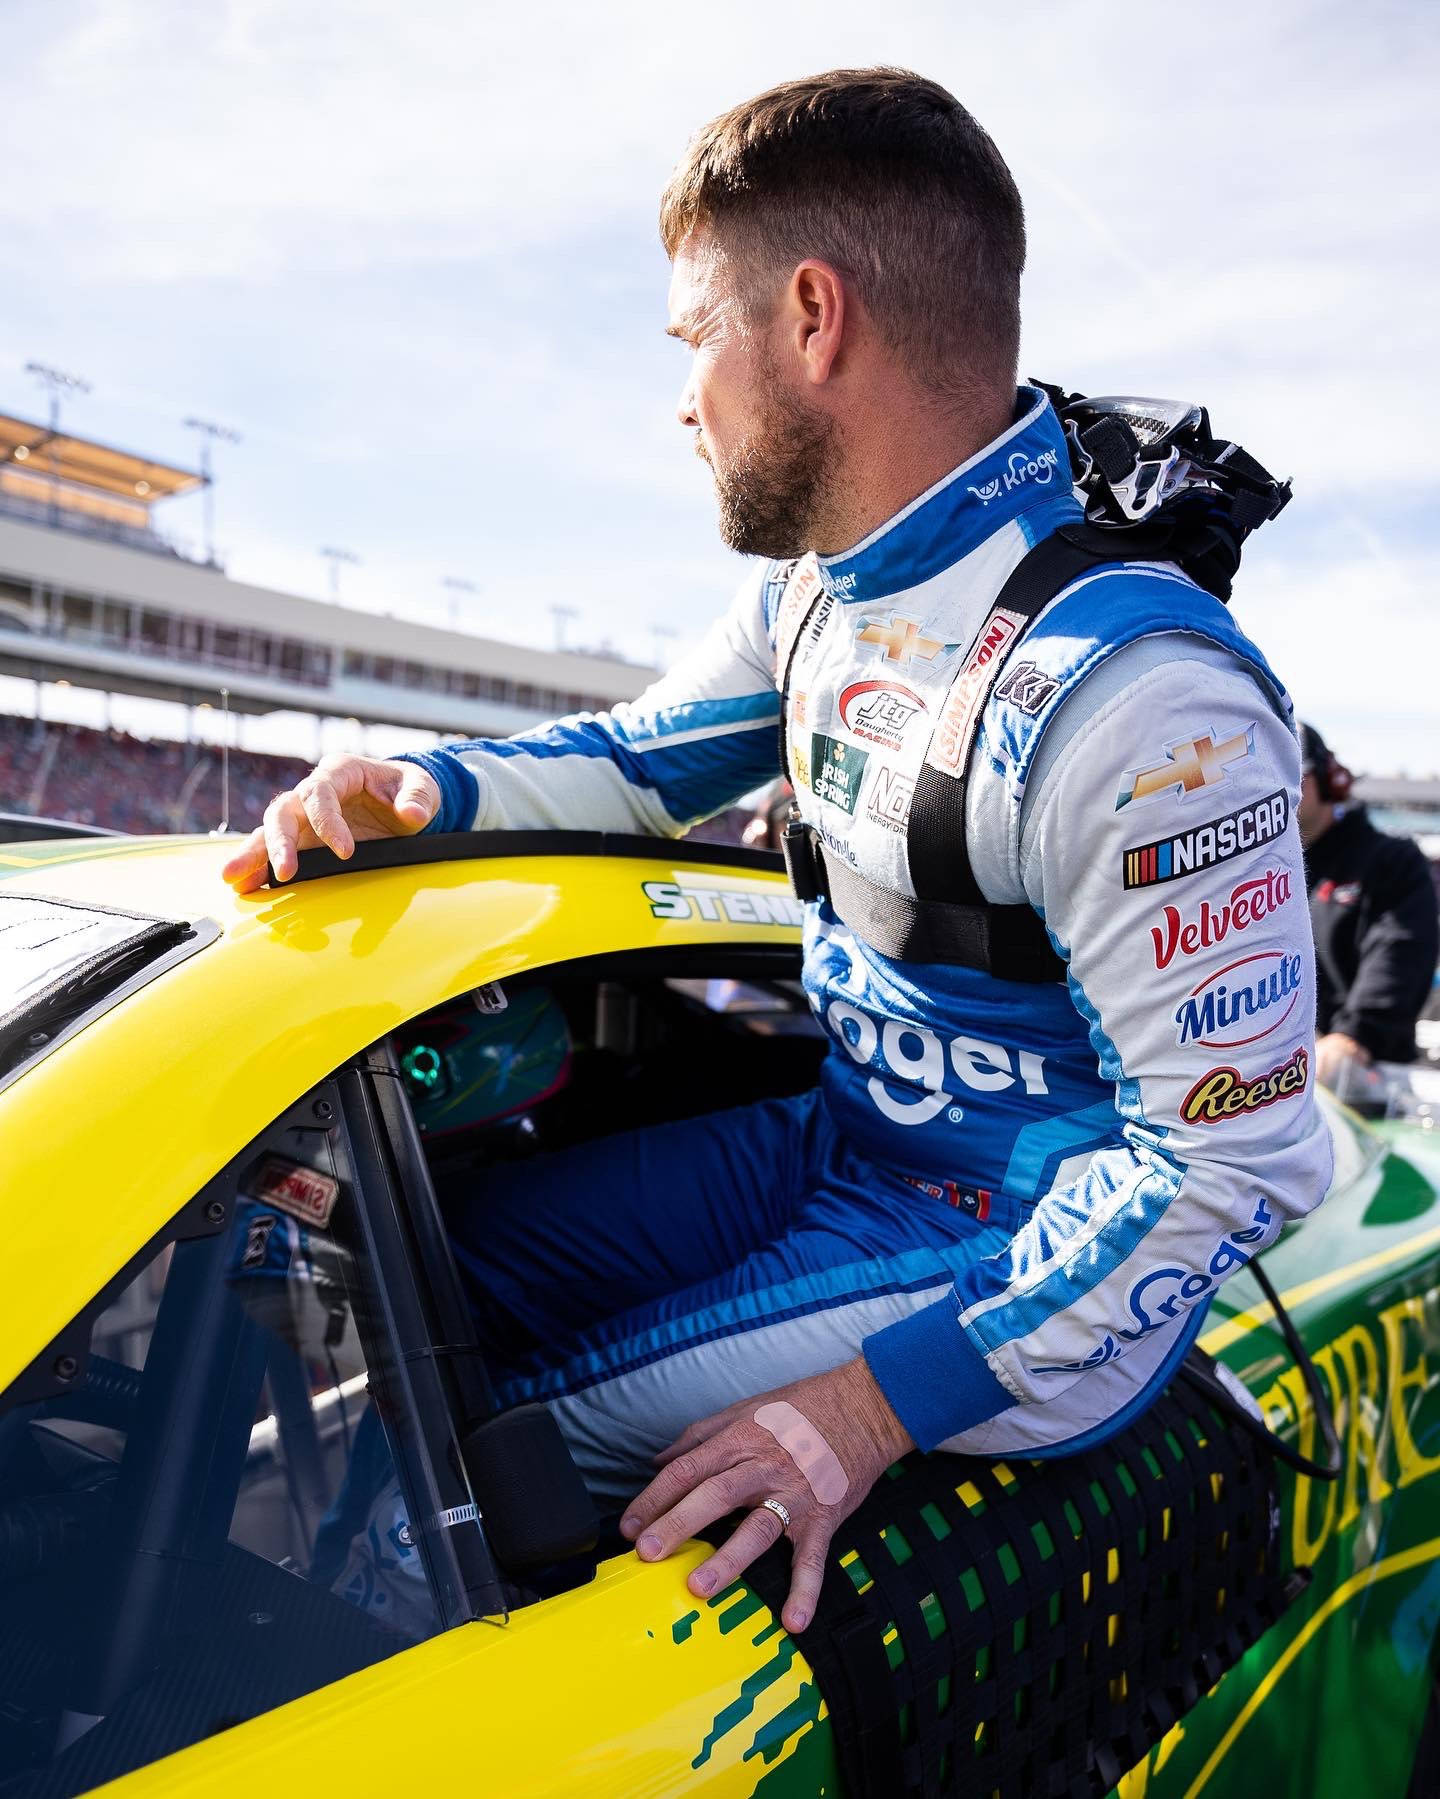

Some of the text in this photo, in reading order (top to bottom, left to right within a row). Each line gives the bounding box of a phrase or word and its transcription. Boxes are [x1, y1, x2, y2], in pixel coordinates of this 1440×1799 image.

[1003, 448, 1057, 491] Kroger
[940, 625, 1006, 756] SIMPSON
[996, 662, 1063, 713] K1
[852, 727, 902, 752] RACING
[855, 718, 904, 742] Daugherty
[814, 778, 851, 810] SPRING
[821, 762, 850, 789] IRISH
[867, 766, 917, 827] NO
[1173, 797, 1286, 875] NASCAR
[1151, 868, 1292, 970] Velveeta
[1175, 953, 1302, 1045] Minute
[827, 1000, 1049, 1126] oger
[1188, 1053, 1308, 1120] Reese's
[1122, 1198, 1273, 1341] Kroger
